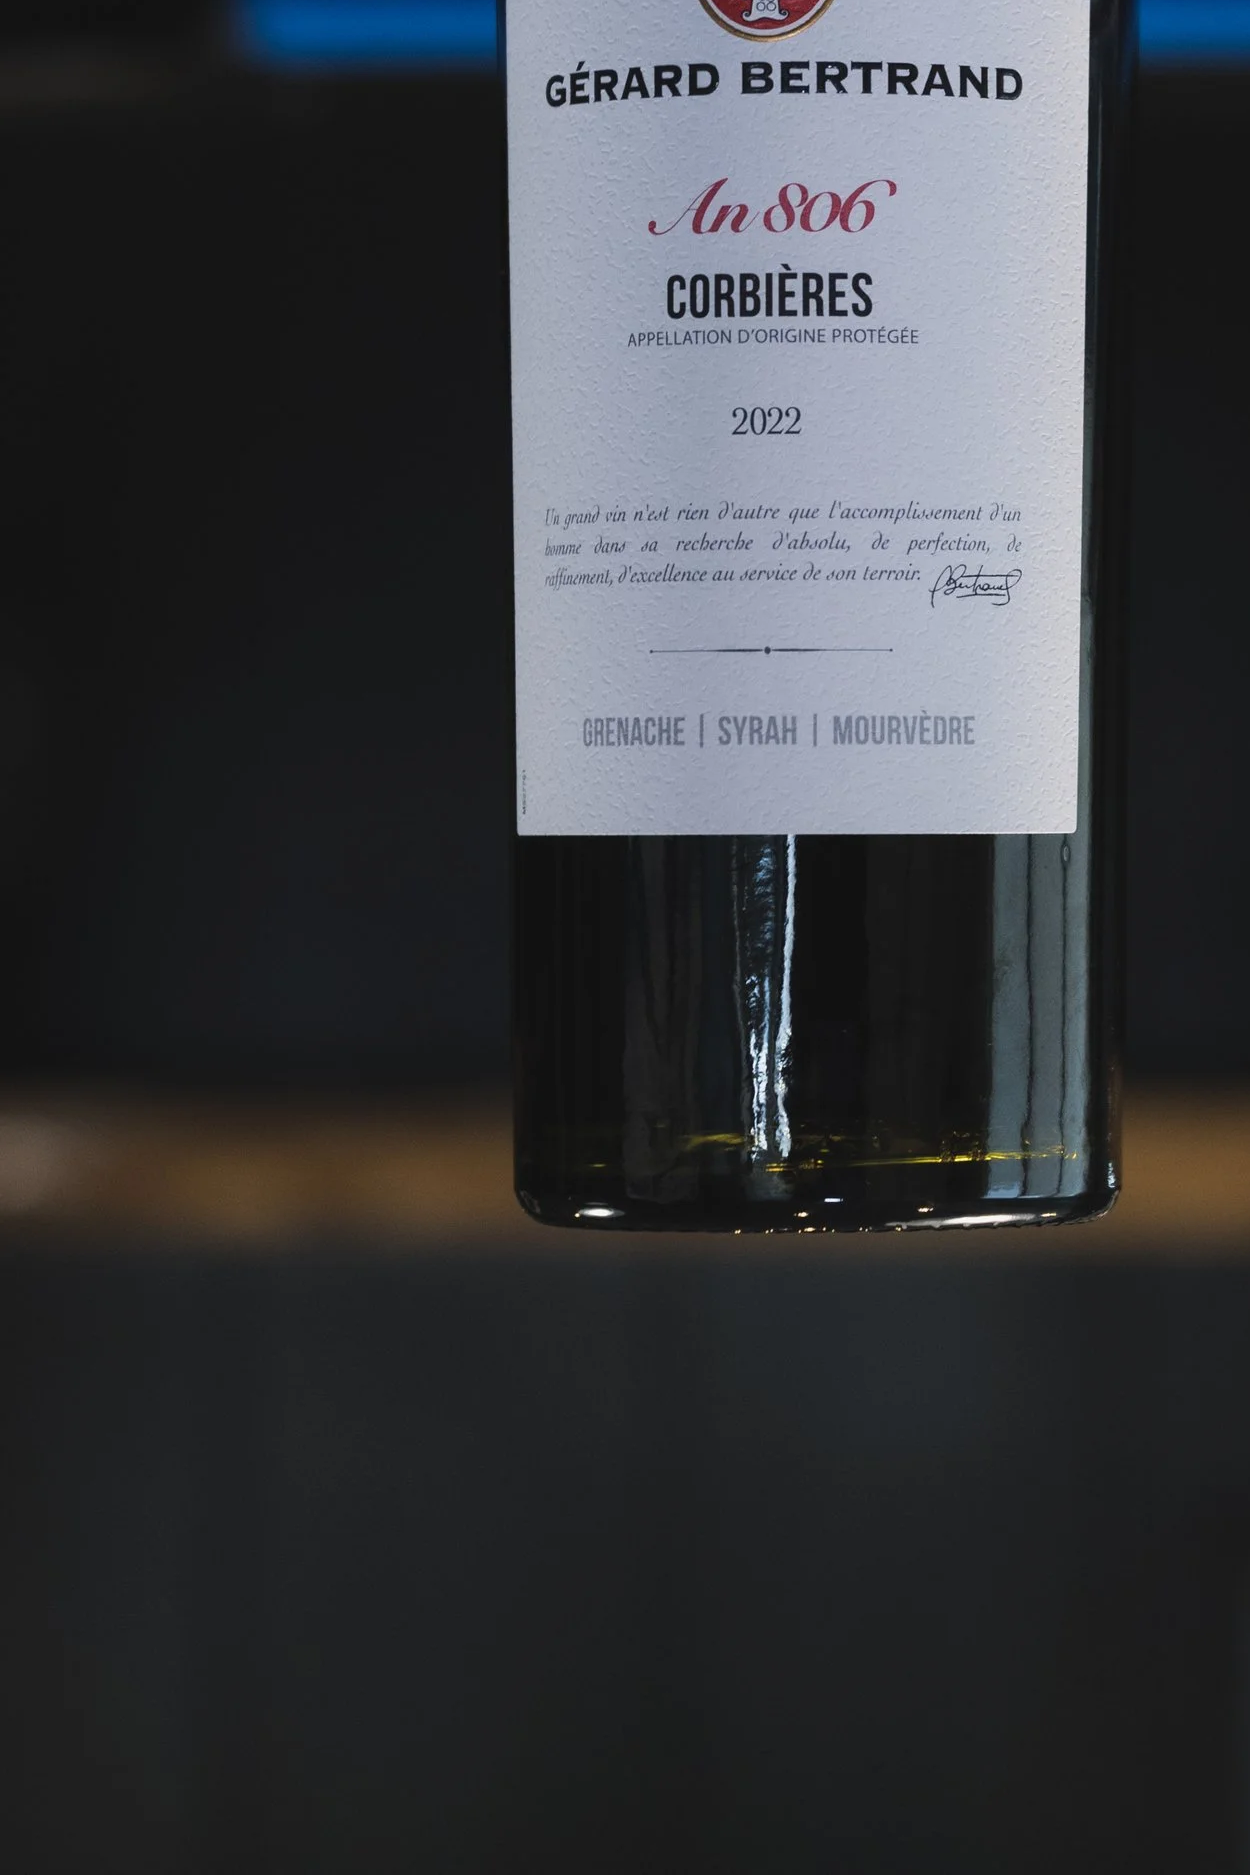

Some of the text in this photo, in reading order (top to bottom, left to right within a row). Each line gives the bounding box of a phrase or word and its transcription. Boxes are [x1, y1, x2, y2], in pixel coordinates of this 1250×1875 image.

[545, 60, 1023, 108] GÉRARD BERTRAND
[648, 177, 897, 236] An 806
[667, 263, 873, 320] CORBIÈRES
[628, 330, 731, 347] APPELLATION
[832, 326, 918, 344] PROTÉGÉE
[732, 407, 801, 435] 2022
[546, 501, 1021, 528] Un grand vin n'est rien d'autre que l'accomplissement d'un
[594, 537, 625, 553] dans
[641, 541, 658, 552] sa
[676, 532, 753, 551] recherche
[772, 531, 850, 552] d'absolu,
[871, 532, 890, 549] de
[906, 532, 989, 555] perfection,
[1007, 536, 1021, 552] de
[618, 563, 707, 583] d'excellence
[712, 570, 734, 581] au
[740, 563, 797, 581] service
[803, 563, 821, 580] de
[826, 570, 856, 580] son
[863, 563, 920, 580] terroir.
[583, 710, 975, 747] GRENACHE SYRAH MOURVÈDRE
